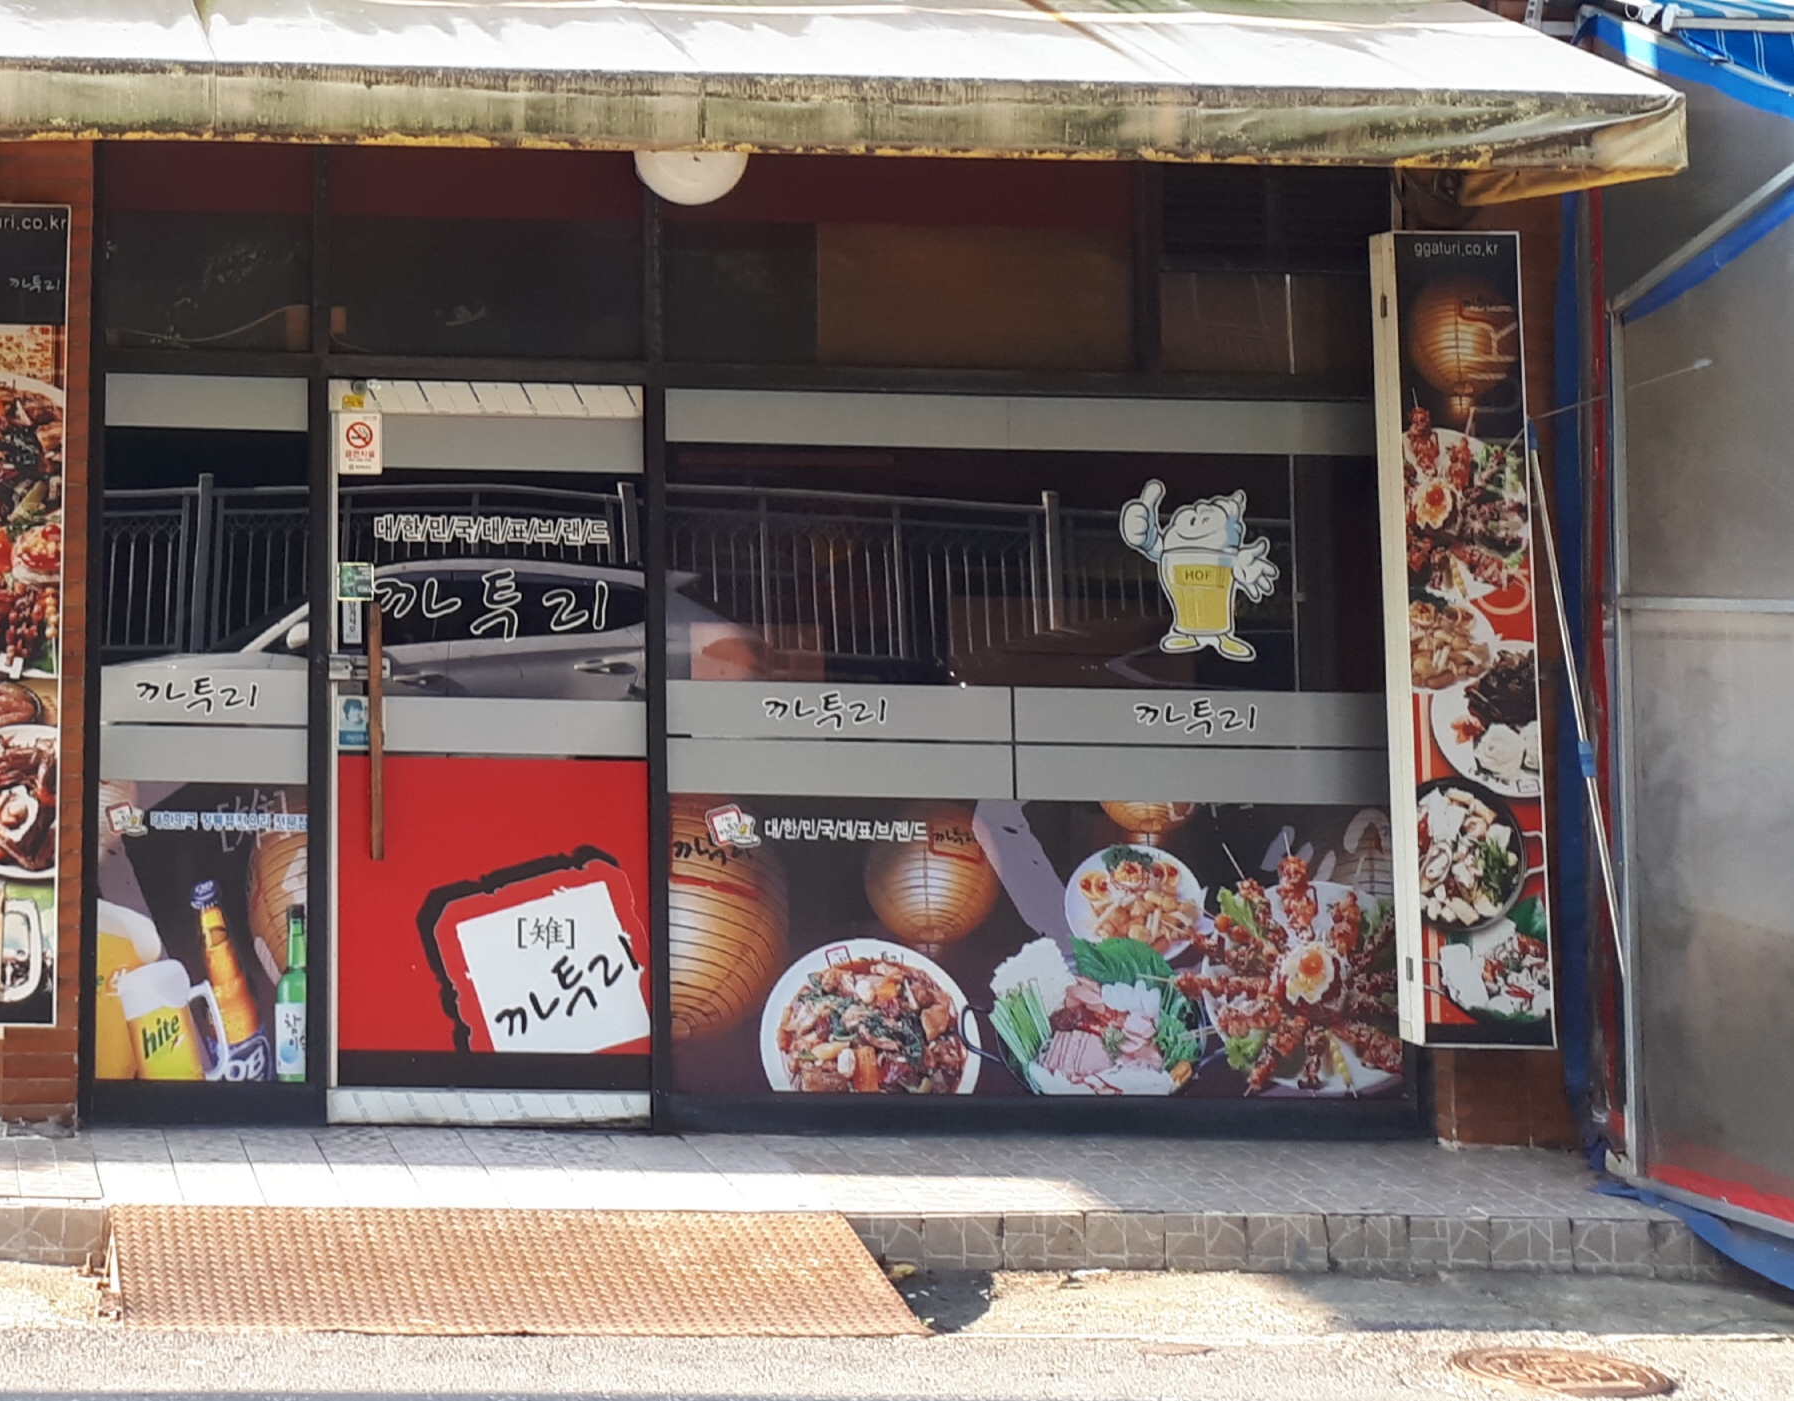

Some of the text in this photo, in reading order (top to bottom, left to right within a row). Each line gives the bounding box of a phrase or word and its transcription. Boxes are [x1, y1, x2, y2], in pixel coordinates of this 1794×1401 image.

[1413, 240, 1499, 258] ggaturi.co.kr
[1184, 569, 1213, 581] HOF
[372, 567, 609, 643] 까투리
[136, 676, 259, 715] 까투리
[762, 690, 888, 730] 까투리
[1134, 698, 1258, 737] 까투리
[494, 933, 640, 1037] 까투리
[141, 1015, 181, 1060] hite
